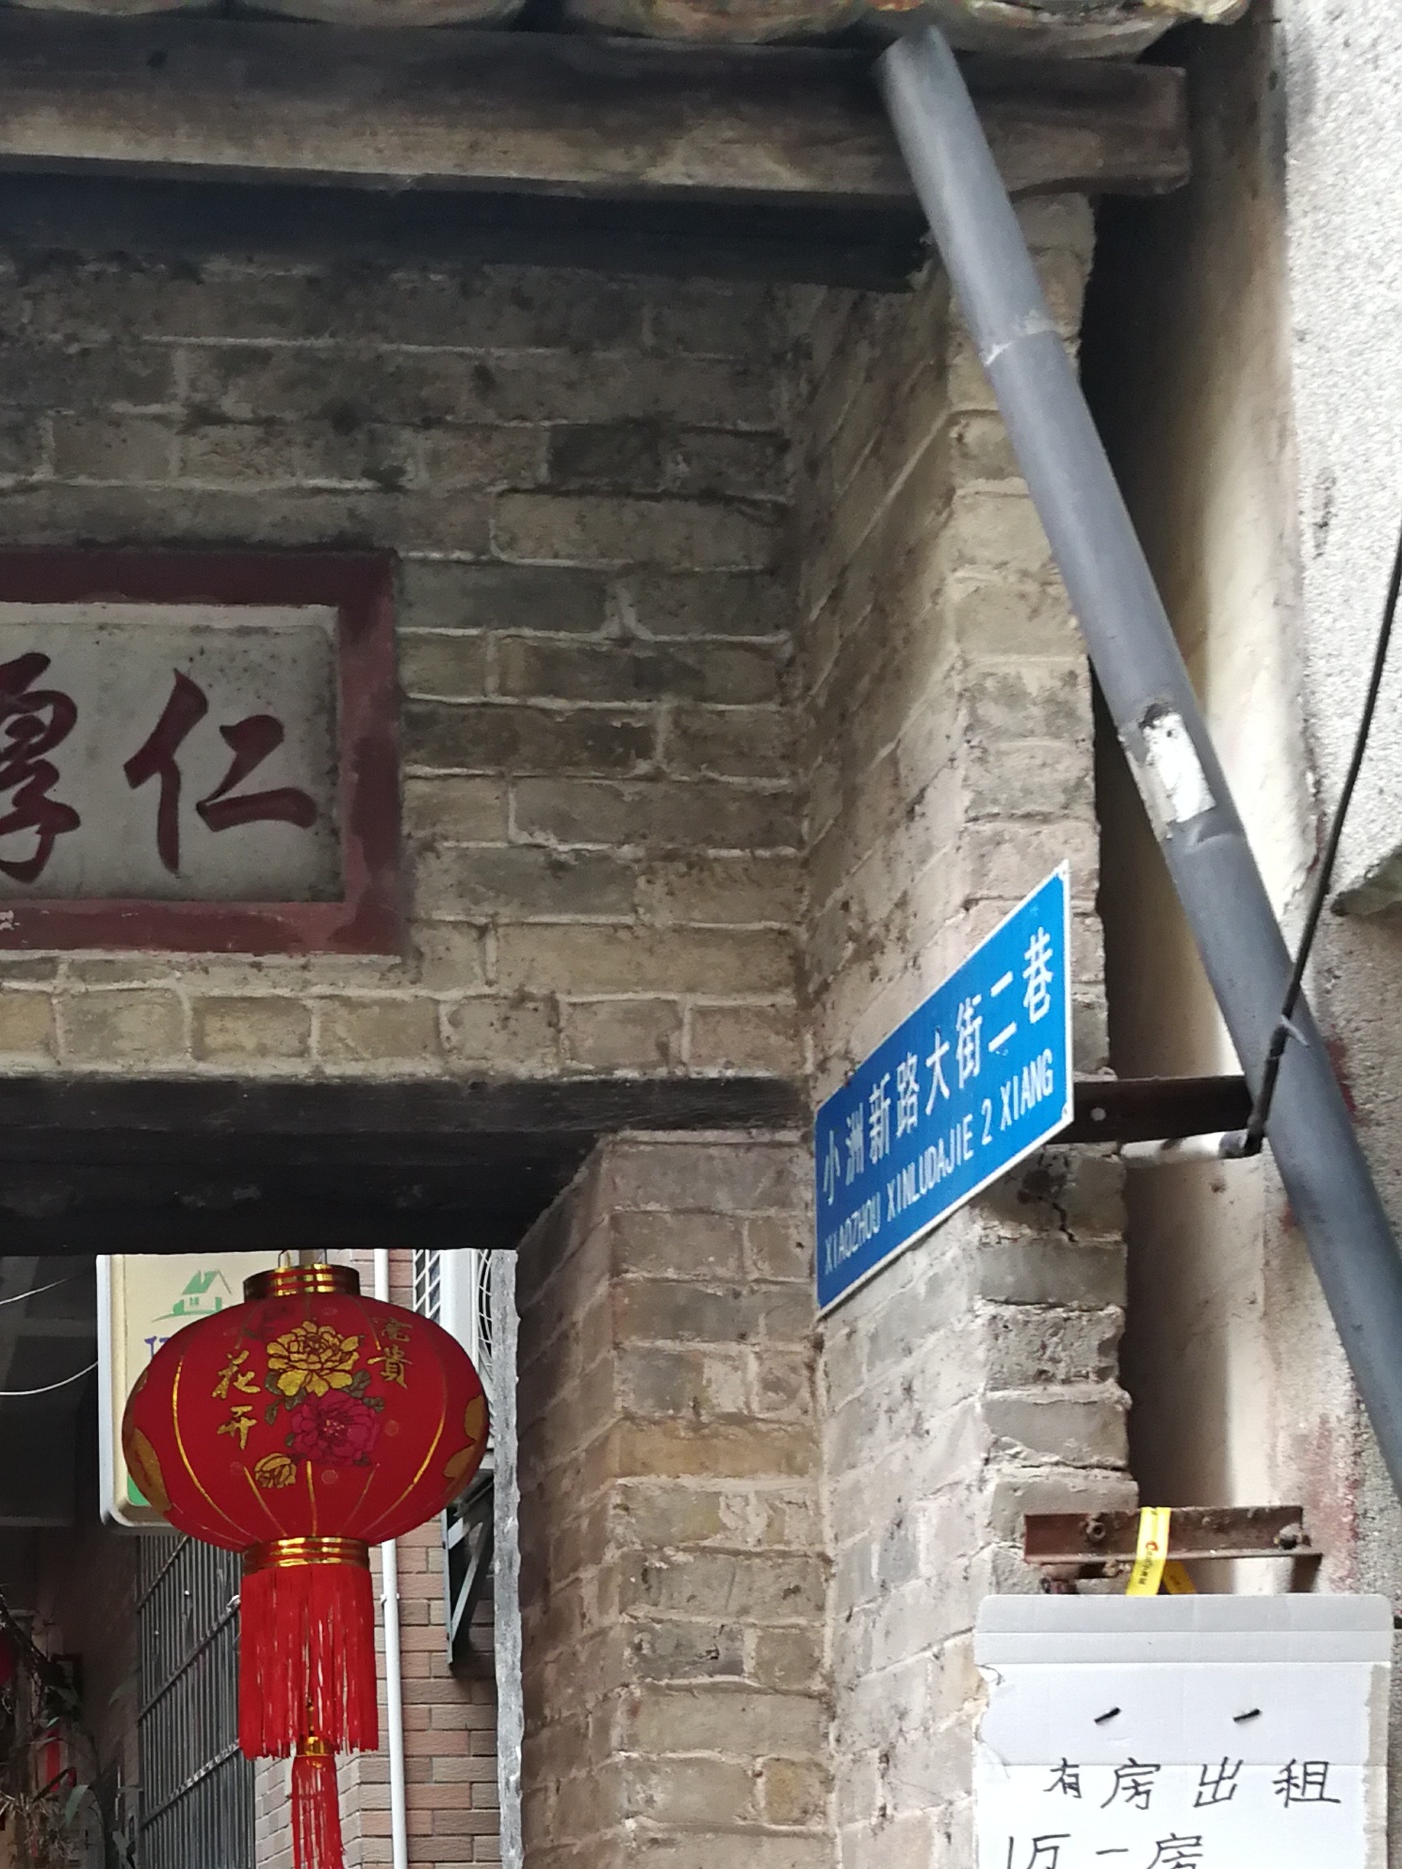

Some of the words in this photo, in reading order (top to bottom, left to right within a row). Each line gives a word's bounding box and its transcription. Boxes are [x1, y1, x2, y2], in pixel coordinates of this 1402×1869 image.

[823, 926, 1054, 1206] 小洲新路大街二巷
[824, 1191, 882, 1276] XIAOZHOU
[886, 1113, 974, 1222] XINLUDAJIE
[981, 1098, 993, 1146] 2
[1000, 1048, 1054, 1131] XIANG
[1043, 1757, 1341, 1810] 有房出租
